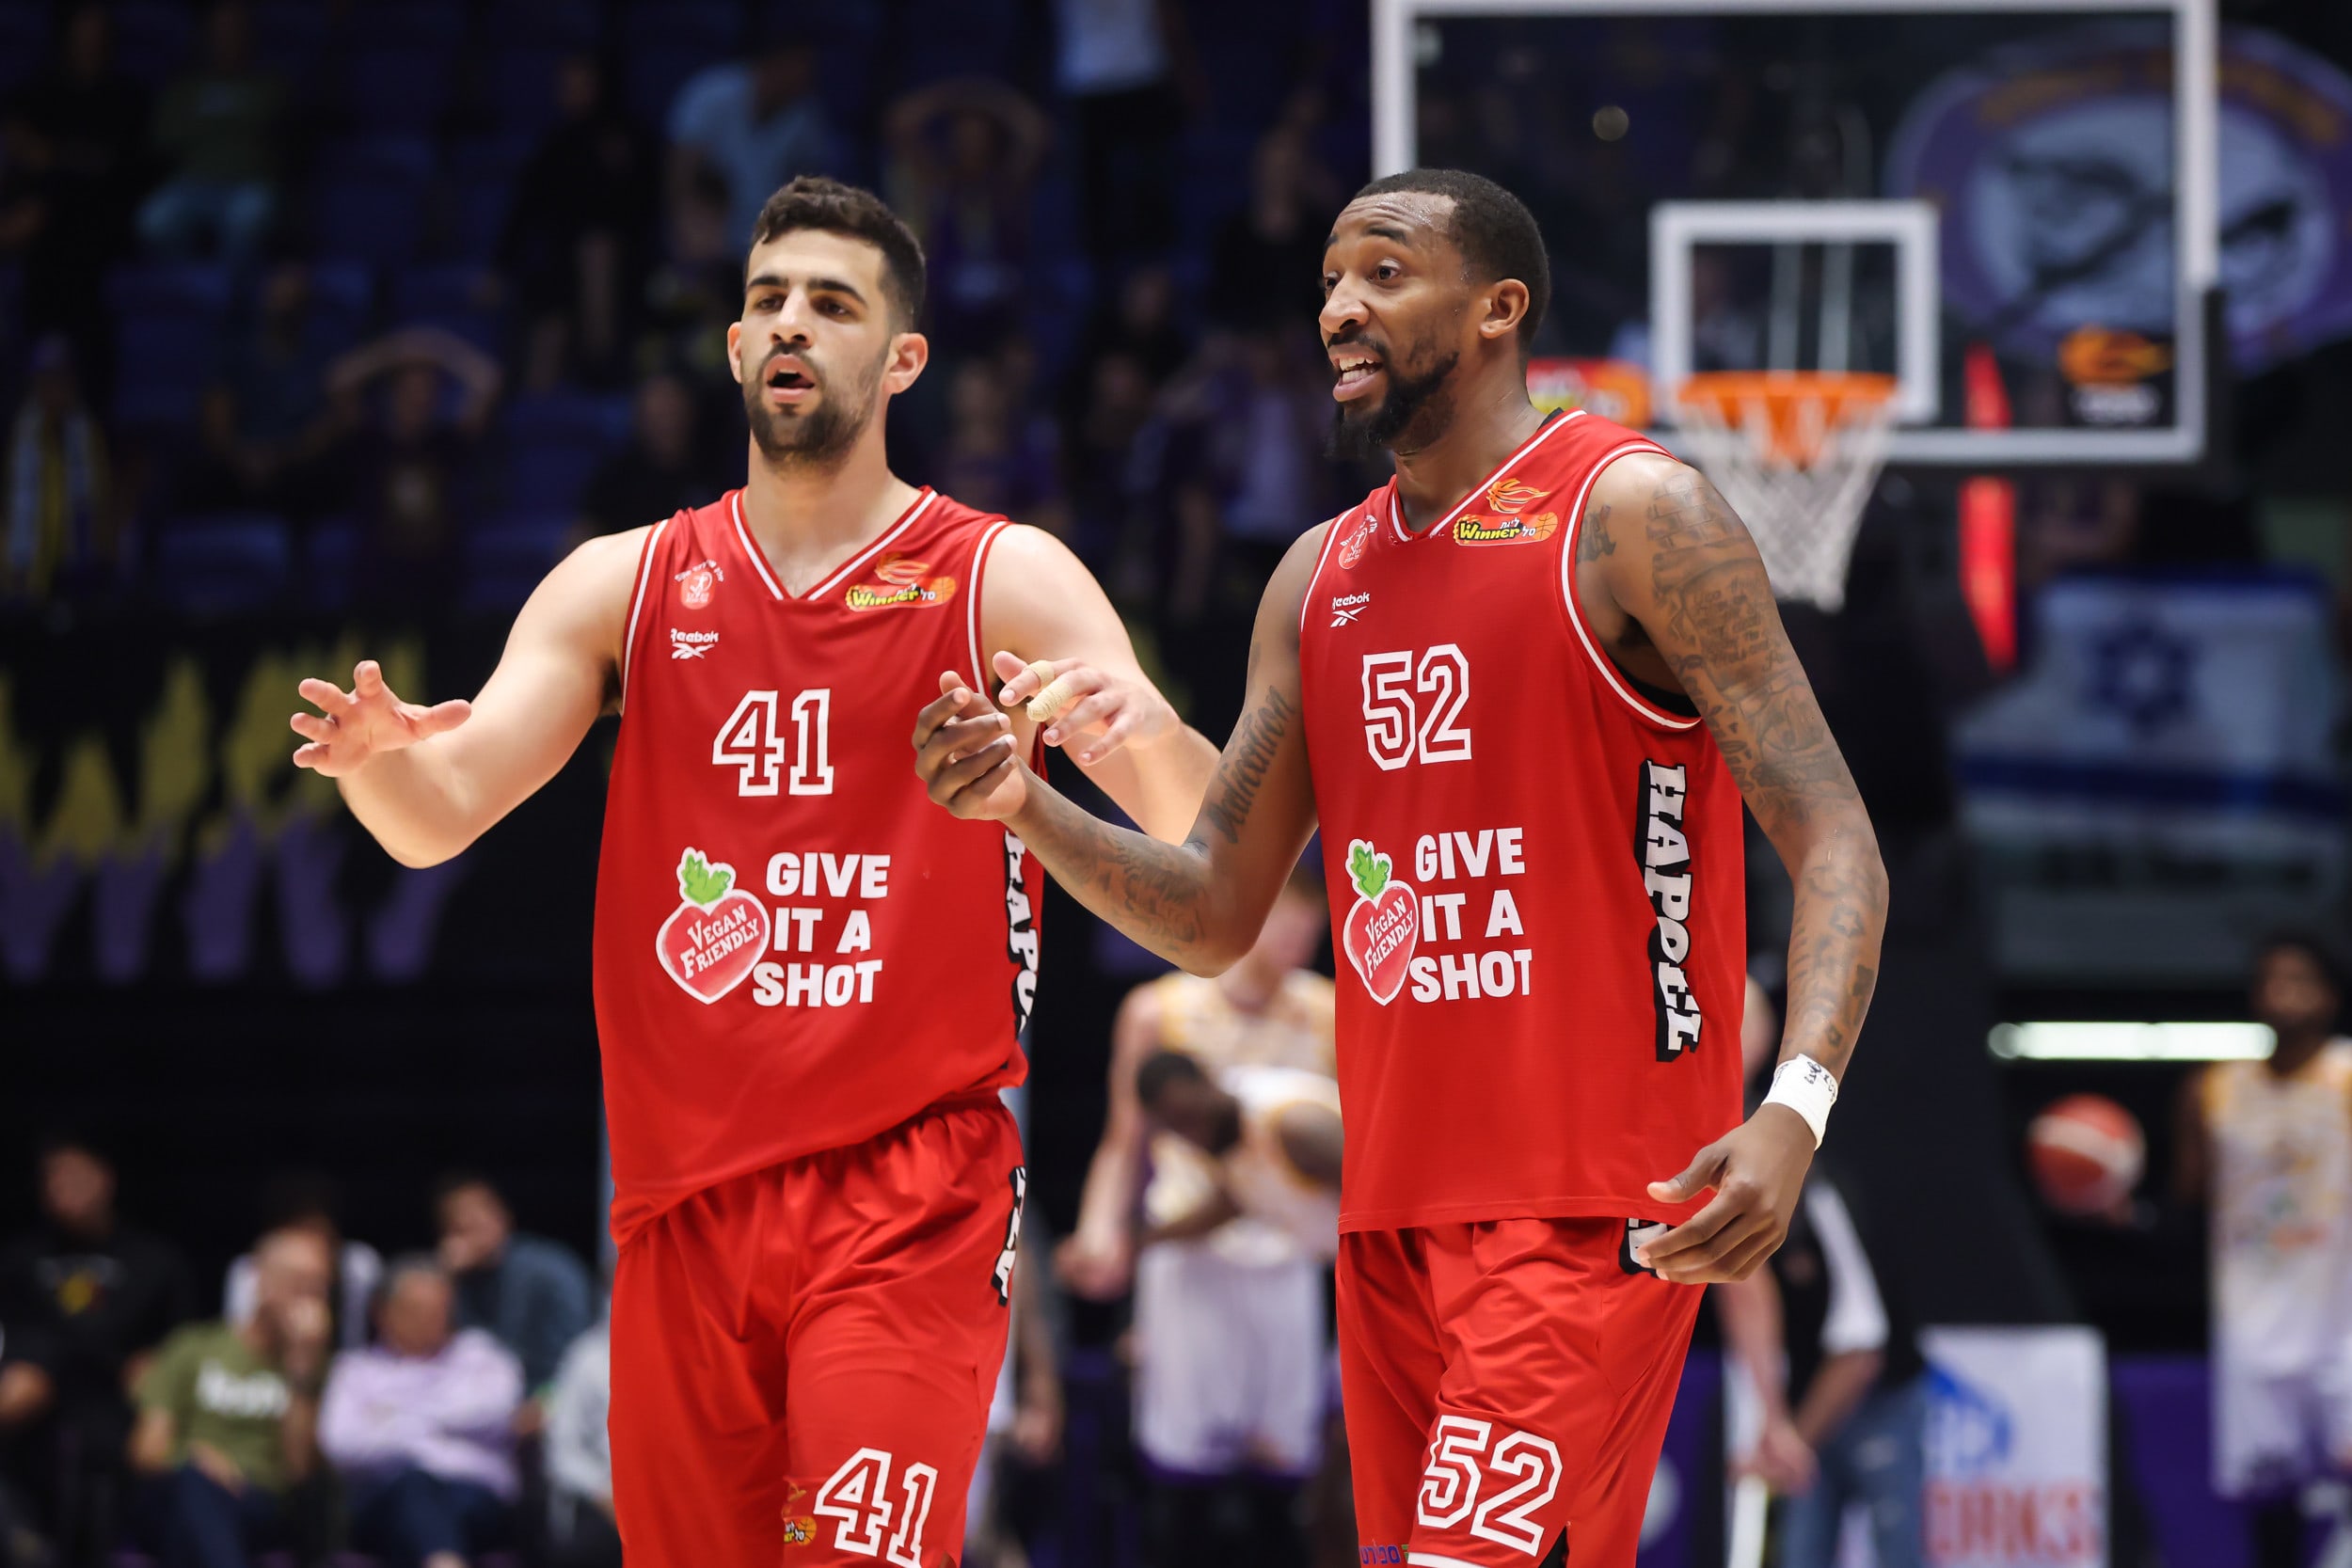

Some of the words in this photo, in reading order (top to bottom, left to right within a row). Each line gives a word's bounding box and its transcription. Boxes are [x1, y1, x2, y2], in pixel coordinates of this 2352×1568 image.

[1459, 522, 1520, 539] Winner
[851, 590, 919, 606] Winner
[671, 627, 719, 642] Reebok
[1361, 643, 1472, 771] 52
[712, 689, 834, 797] 41
[766, 851, 891, 898] GIVE
[1415, 827, 1525, 882] GIVE
[687, 904, 748, 951] VEGAN
[773, 907, 823, 952] IT
[835, 910, 871, 954] A
[1004, 828, 1039, 1035] HAPO
[1365, 895, 1406, 948] VEGAN
[1422, 893, 1466, 942] IT
[1485, 889, 1524, 938] A
[1643, 759, 1702, 1052] HAPOEL
[679, 918, 759, 980] FRIENDLY
[1364, 910, 1414, 980] FRIENDLY
[753, 959, 882, 1007] SHOT
[1409, 949, 1533, 1003] SHOT
[813, 1447, 939, 1568] 41
[1417, 1415, 1563, 1557] 52
